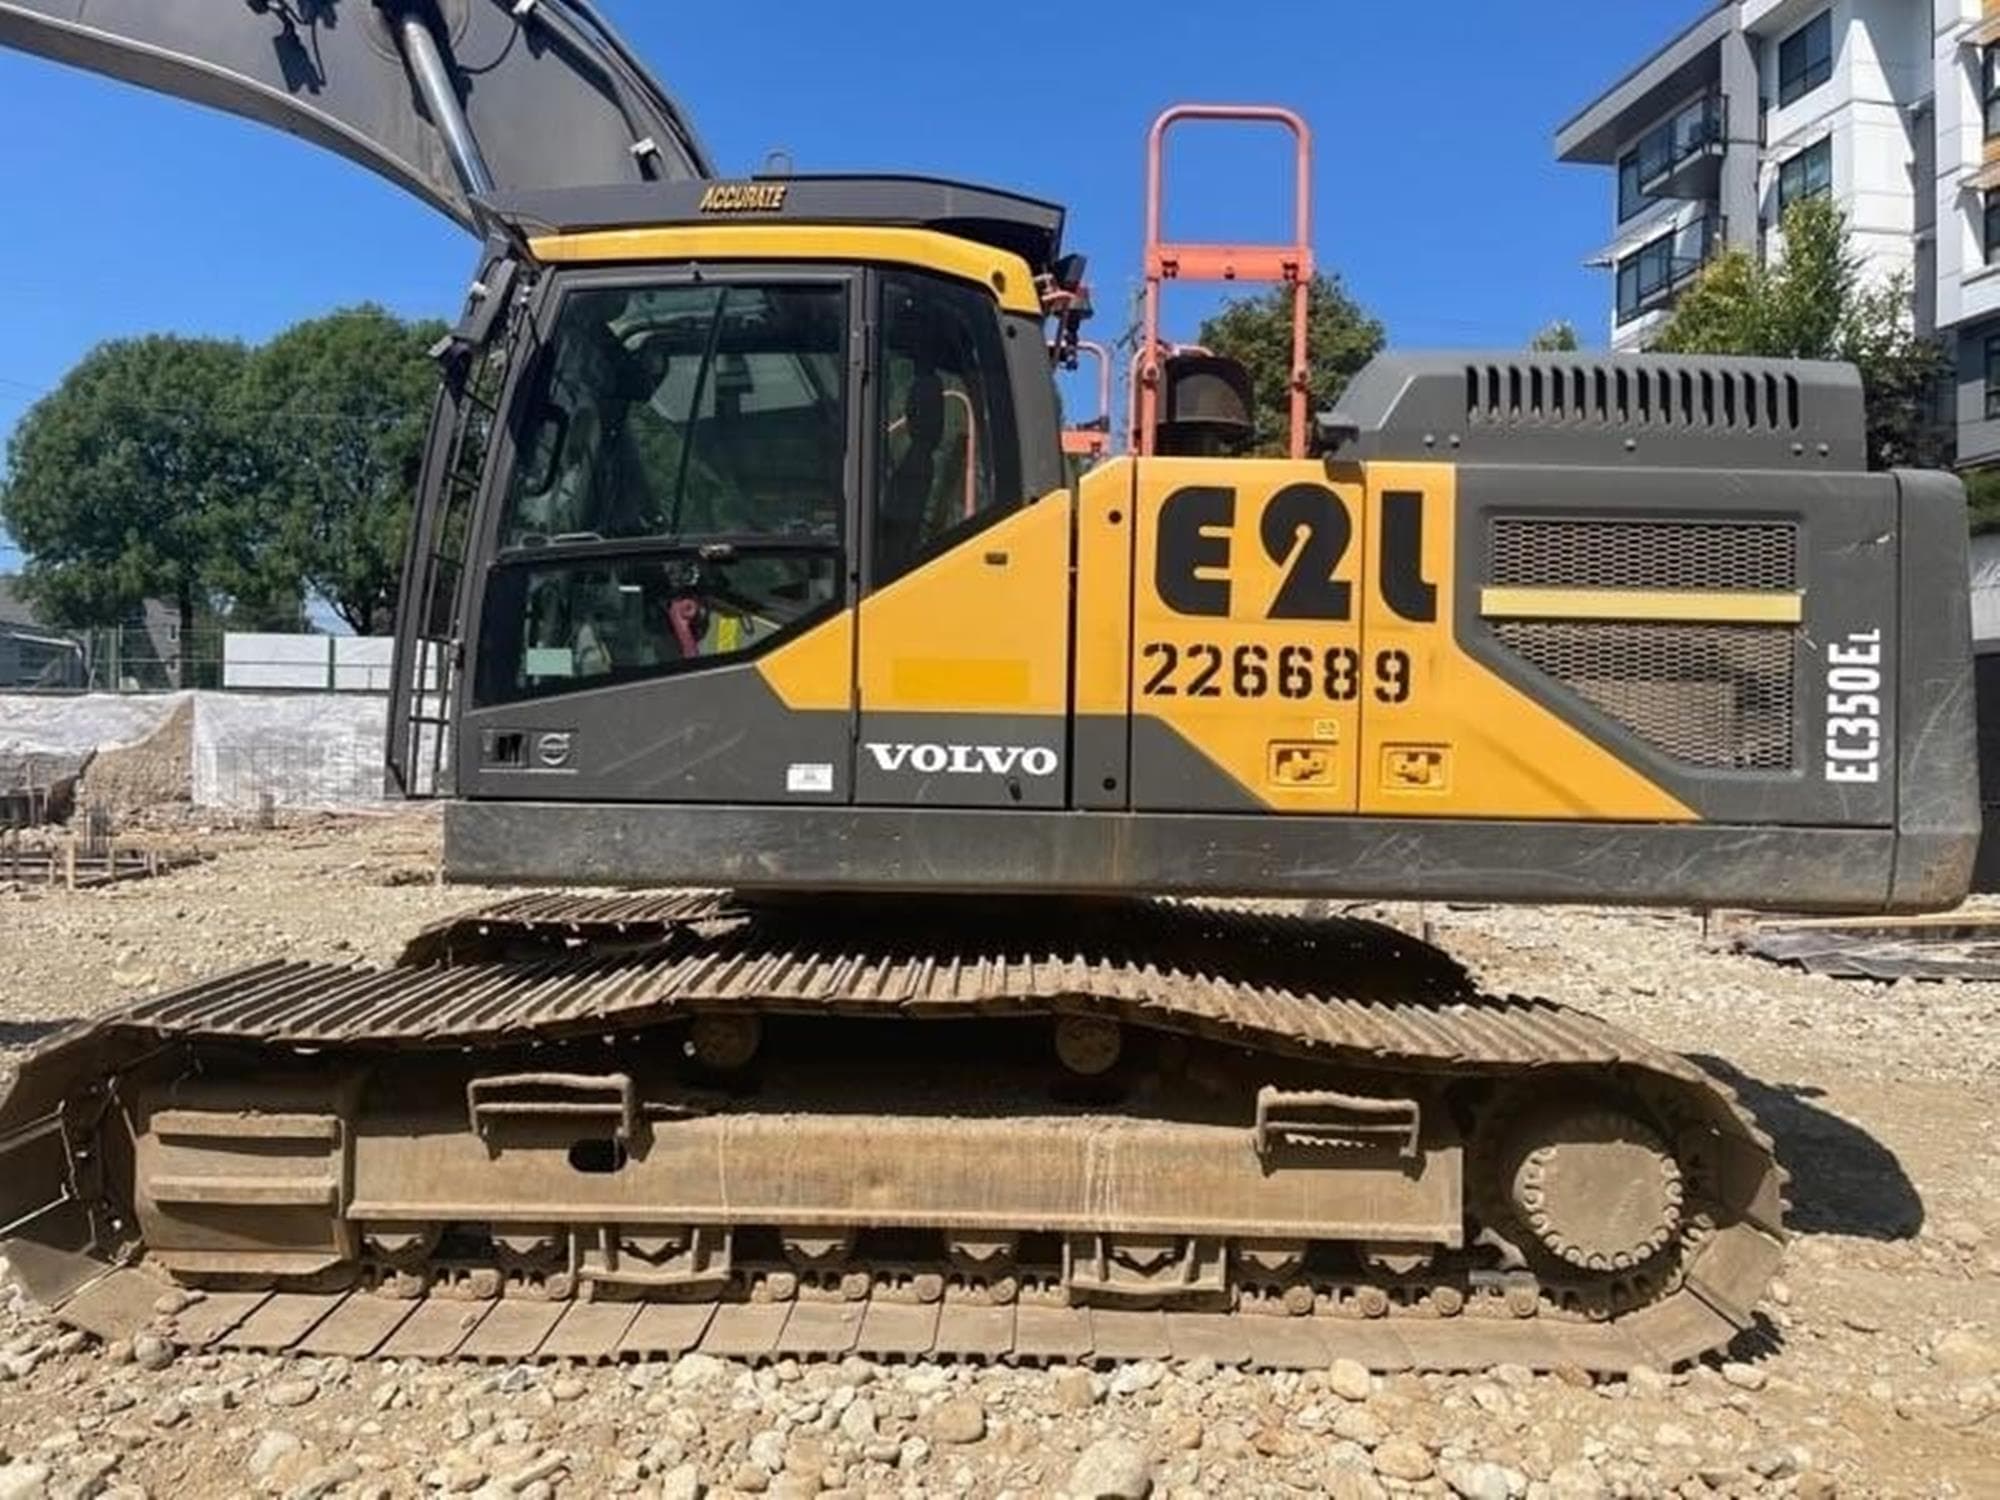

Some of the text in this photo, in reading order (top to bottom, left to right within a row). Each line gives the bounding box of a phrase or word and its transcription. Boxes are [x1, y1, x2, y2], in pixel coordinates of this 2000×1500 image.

[700, 185, 787, 212] ACCURATE
[1143, 643, 1410, 703] 226689
[865, 743, 1058, 775] VOLVO
